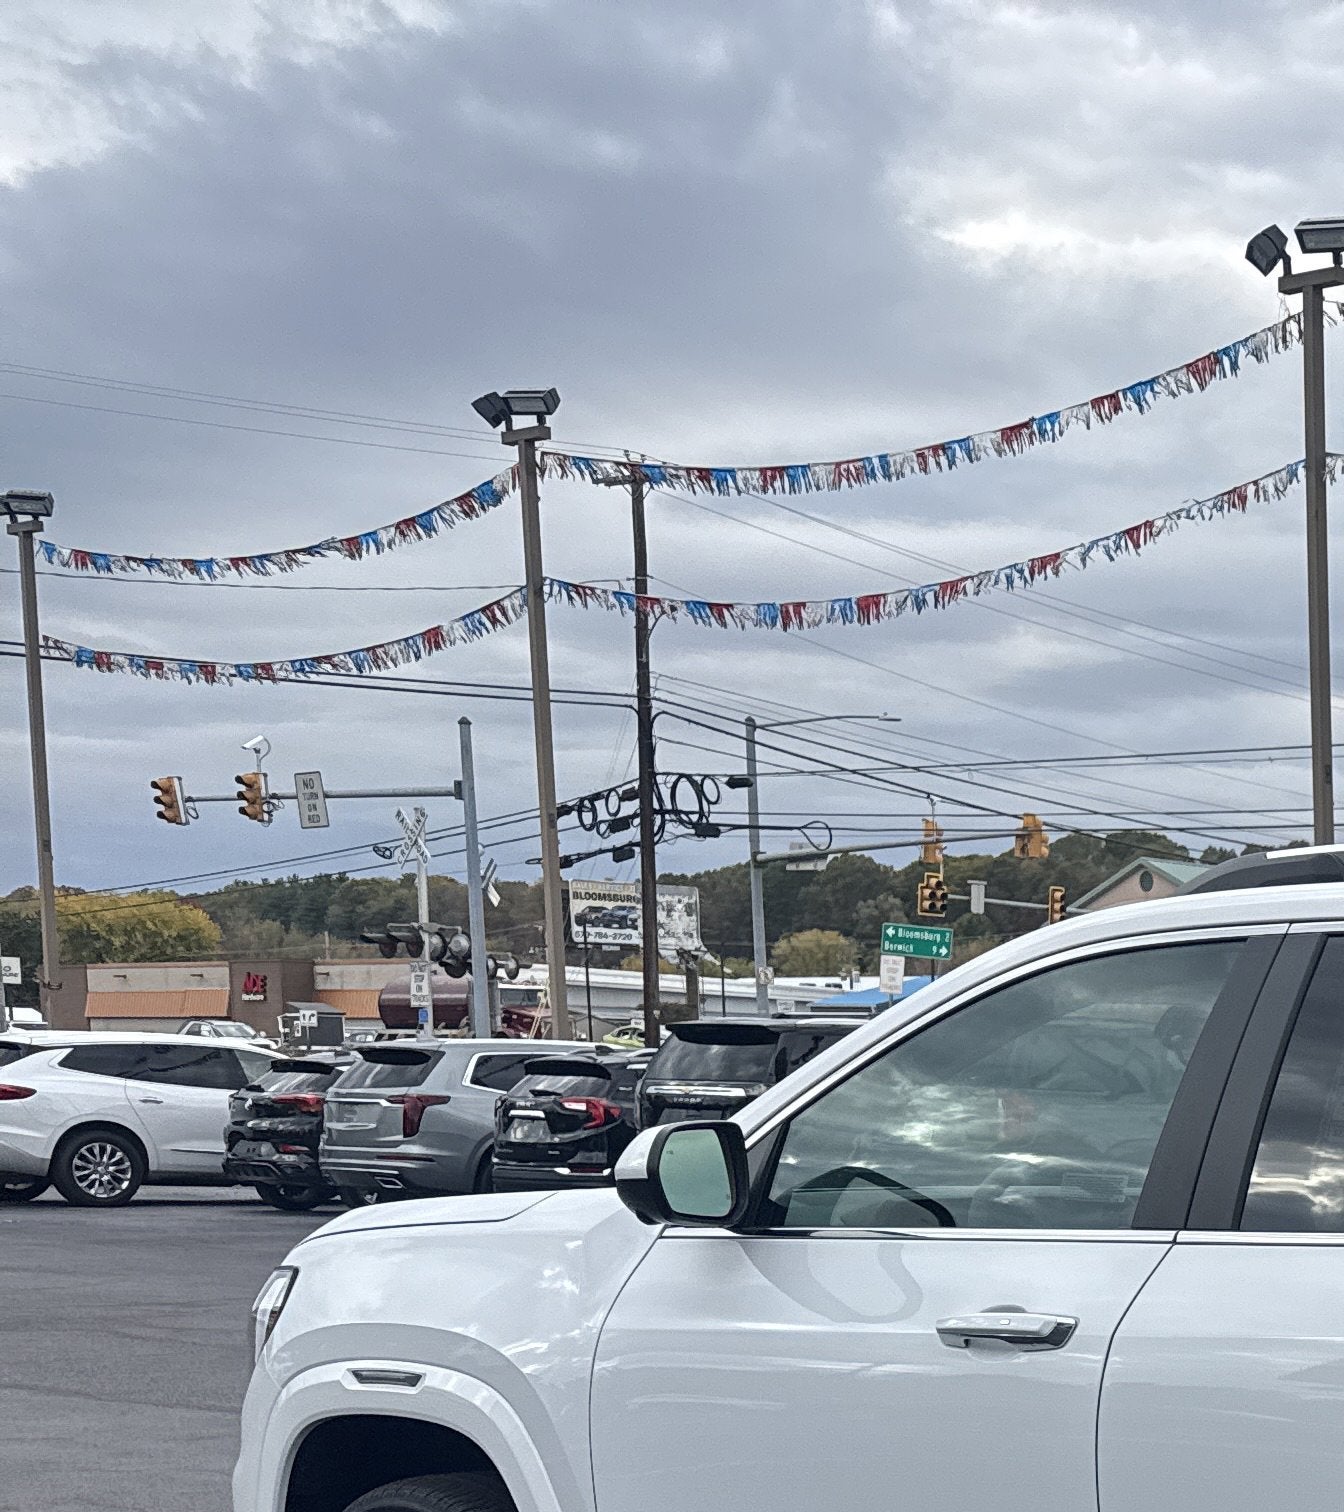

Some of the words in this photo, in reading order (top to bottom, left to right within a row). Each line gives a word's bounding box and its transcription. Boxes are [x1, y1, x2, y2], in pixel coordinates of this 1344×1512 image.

[302, 777, 315, 790] NO
[302, 792, 319, 800] TURN
[307, 803, 317, 812] ON
[307, 814, 320, 824] RED
[397, 808, 427, 865] CROSSING
[898, 928, 940, 943] Bloomsburg
[945, 933, 950, 942] 2
[884, 941, 913, 952] Berwick
[932, 946, 937, 955] 9
[242, 972, 267, 993] ACE
